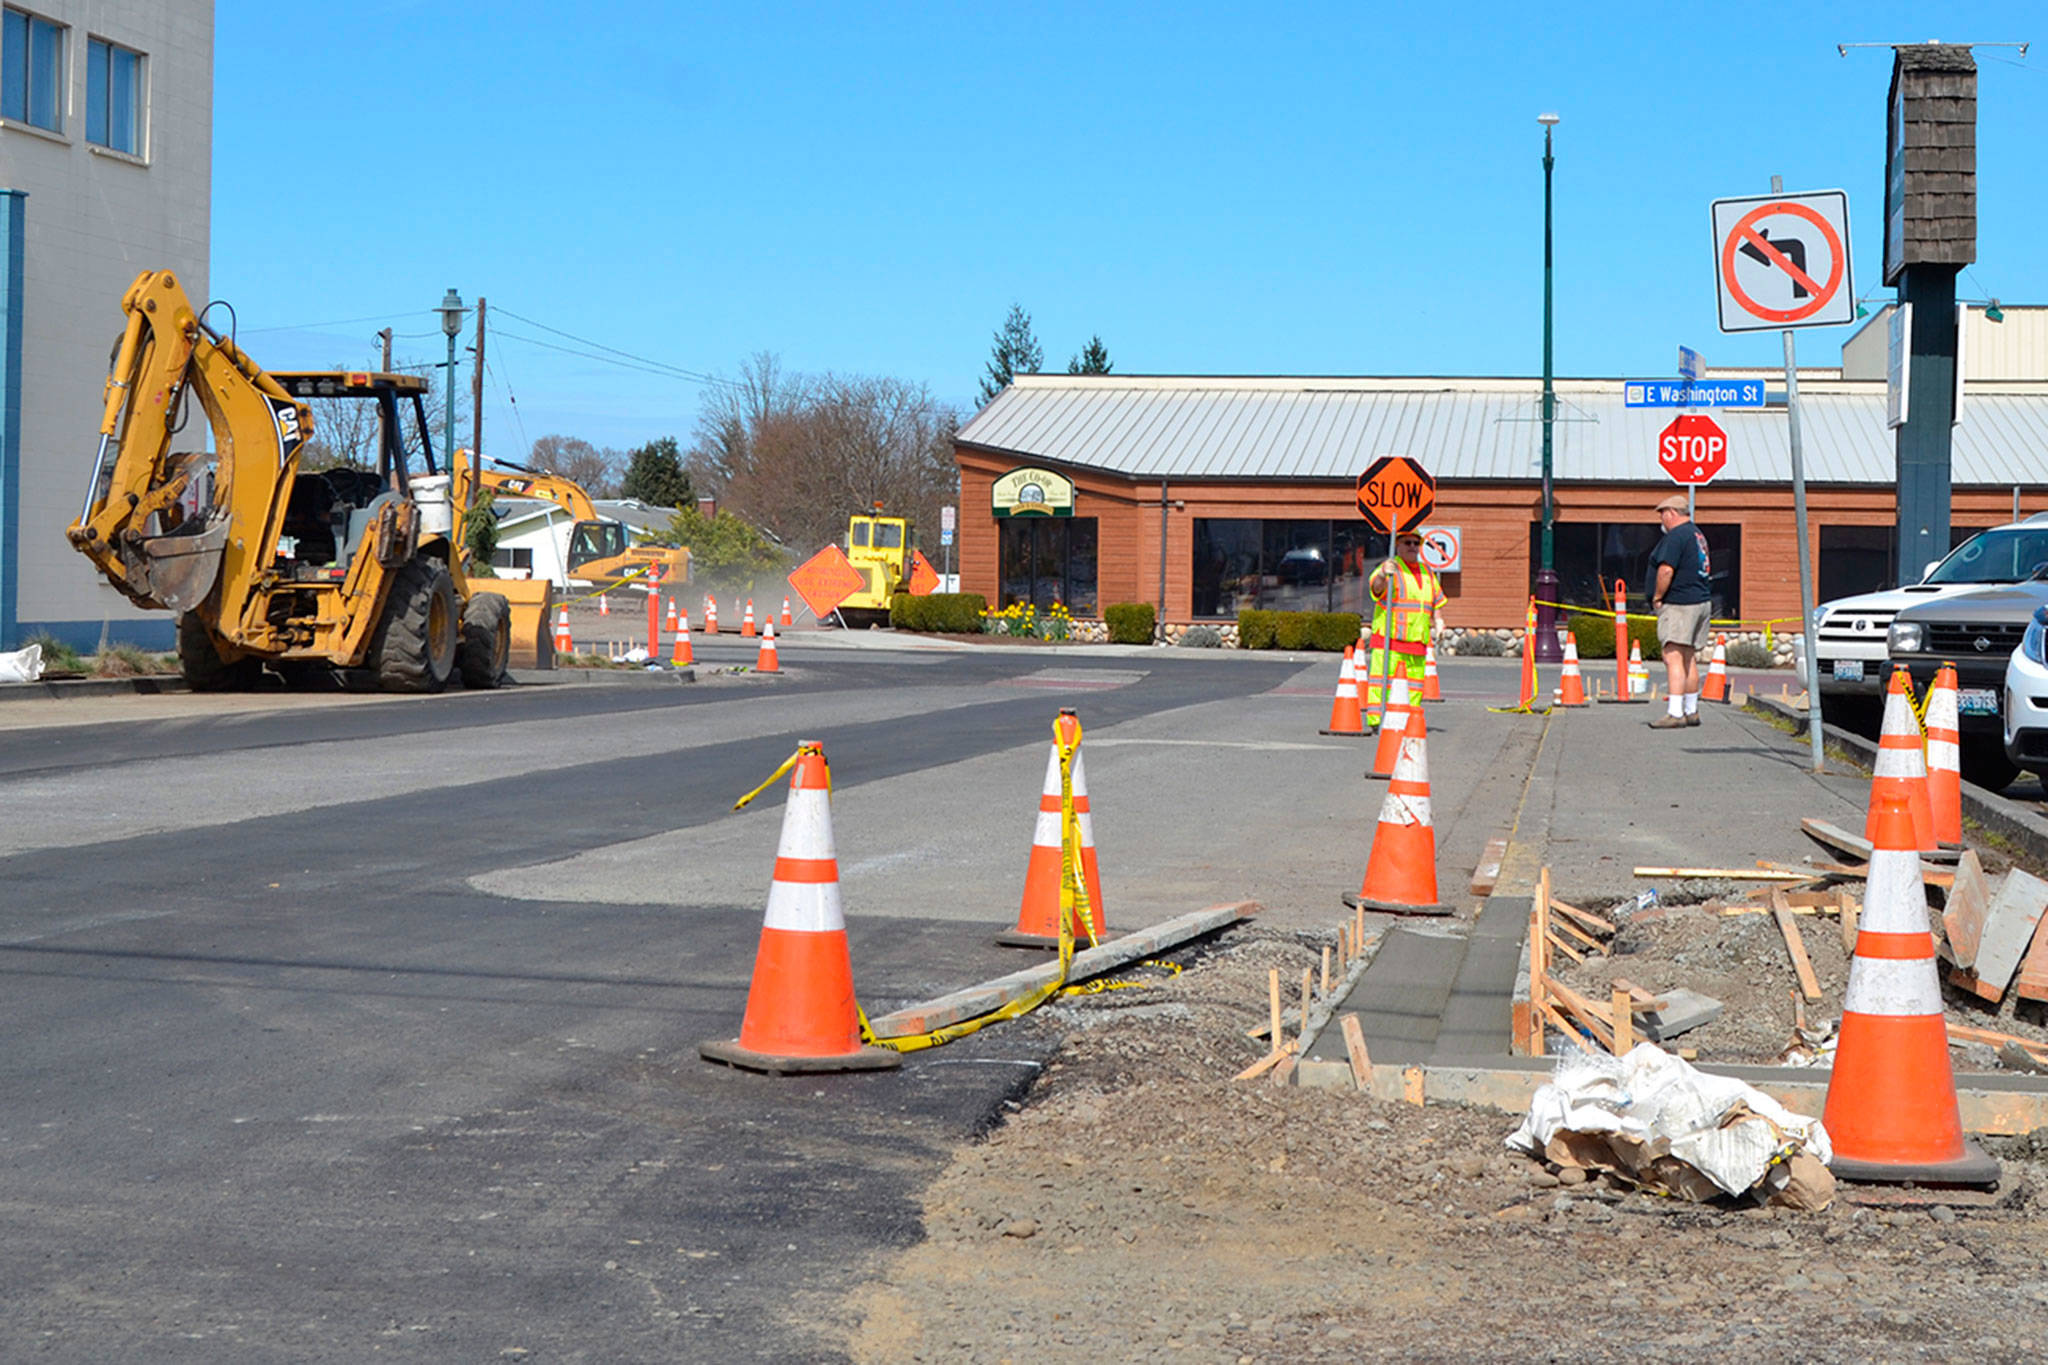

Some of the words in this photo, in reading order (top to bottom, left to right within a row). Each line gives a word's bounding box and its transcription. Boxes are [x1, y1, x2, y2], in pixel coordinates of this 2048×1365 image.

[1647, 386, 1655, 402] E
[1660, 385, 1737, 406] Washington
[1743, 385, 1758, 401] St
[278, 406, 301, 442] CAT
[1662, 435, 1723, 462] STOP
[508, 479, 525, 491] CAT
[1367, 481, 1422, 508] SLOW
